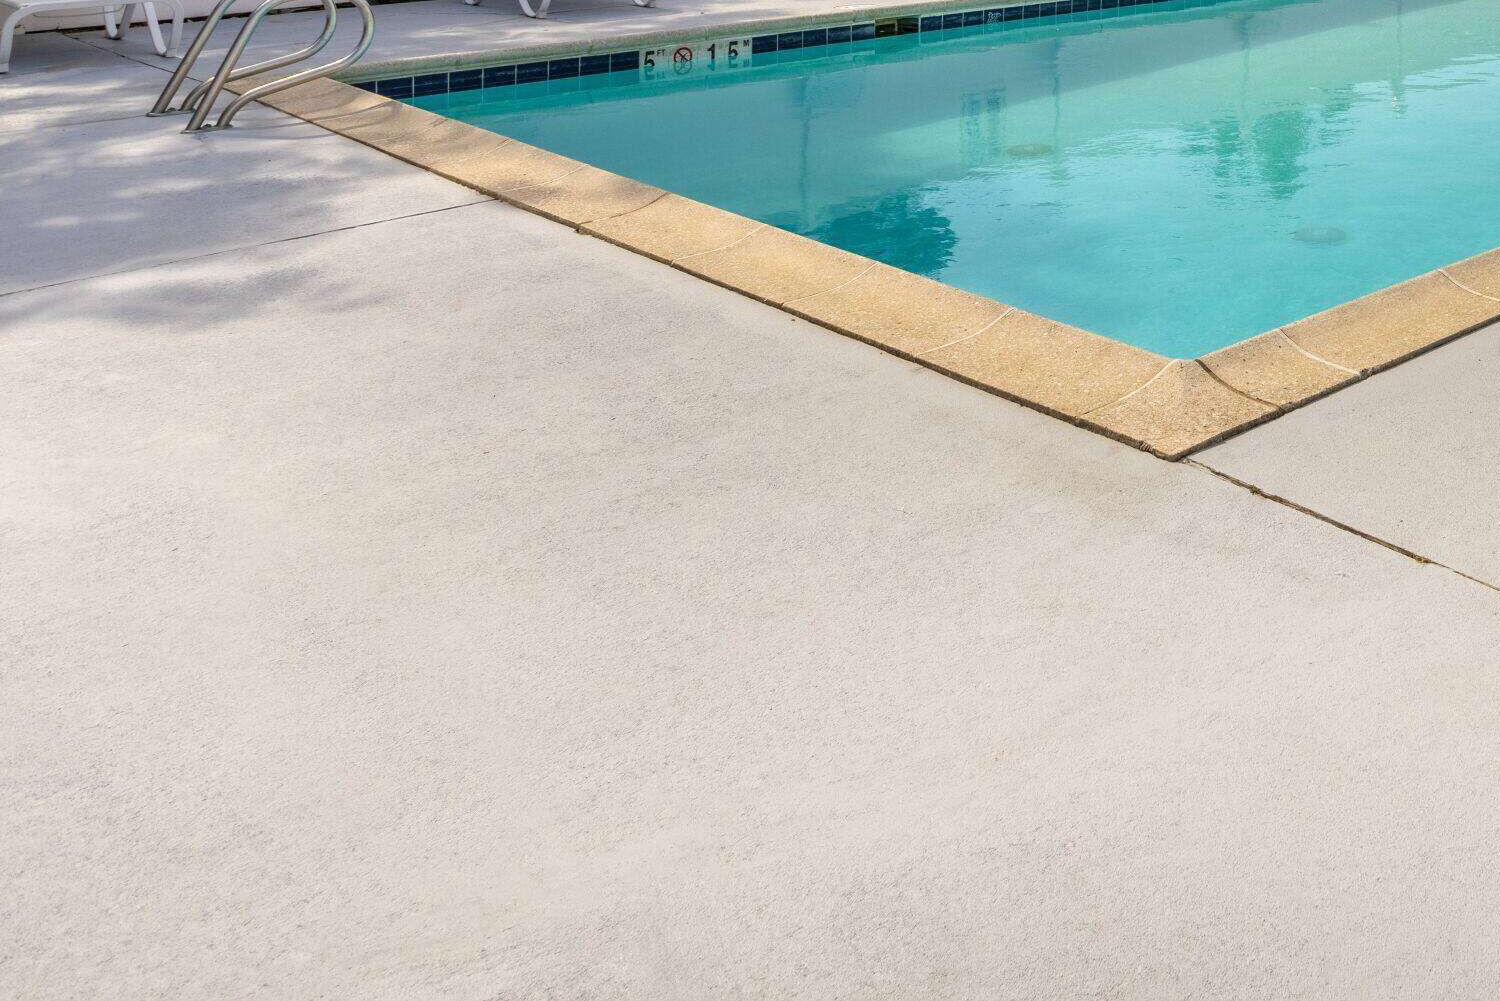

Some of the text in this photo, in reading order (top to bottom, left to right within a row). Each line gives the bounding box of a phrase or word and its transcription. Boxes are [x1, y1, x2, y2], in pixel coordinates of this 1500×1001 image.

[644, 50, 655, 67] 5
[707, 43, 716, 60] 1
[728, 40, 738, 57] 5
